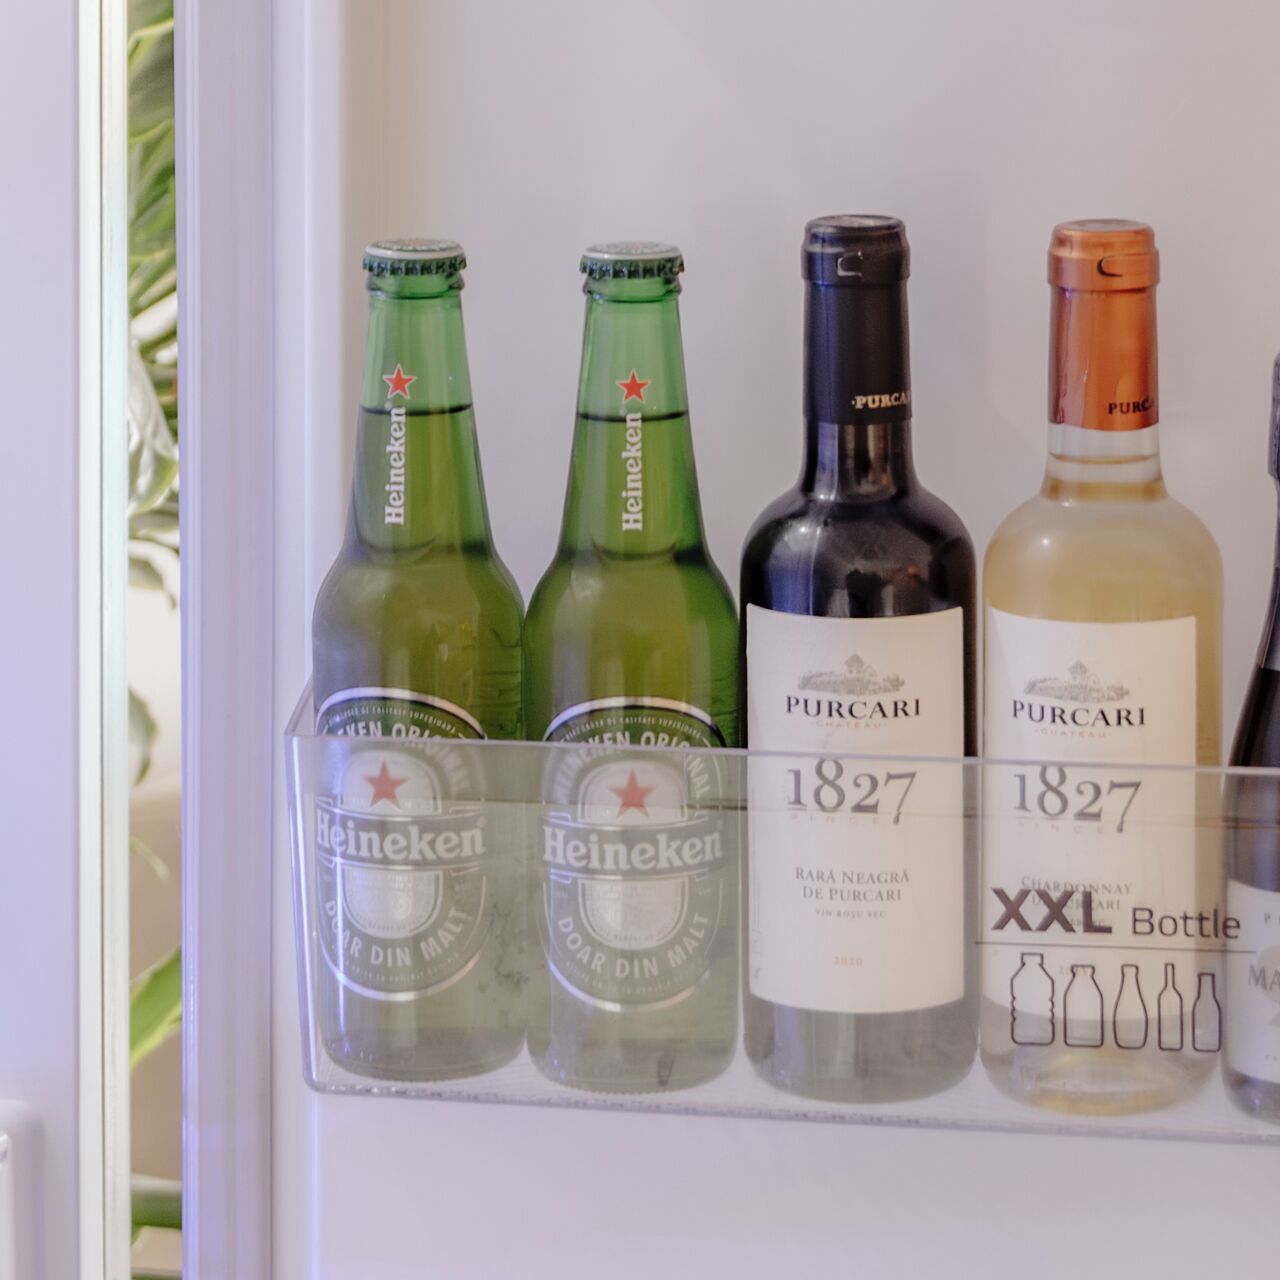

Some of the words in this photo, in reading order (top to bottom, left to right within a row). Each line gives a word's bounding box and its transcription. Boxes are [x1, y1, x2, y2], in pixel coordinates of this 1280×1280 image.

[854, 391, 911, 410] PURCA
[1107, 399, 1153, 416] PURC
[384, 406, 407, 526] Heineken
[622, 412, 644, 532] Heineken
[786, 695, 921, 720] PURCARI
[1012, 699, 1147, 728] PURCARI
[787, 756, 918, 825] 1827
[1013, 765, 1143, 834] 1827
[316, 808, 487, 861] Heineken
[543, 826, 723, 871] Heineken
[803, 886, 823, 900] DE
[829, 887, 902, 902] PURCARI
[991, 887, 1113, 934] XXL
[1132, 906, 1241, 941] Bottle
[371, 945, 412, 968] DIN
[420, 906, 468, 961] MALT
[558, 917, 607, 973] DOAR
[615, 956, 659, 980] DIN
[667, 912, 710, 968] MALT
